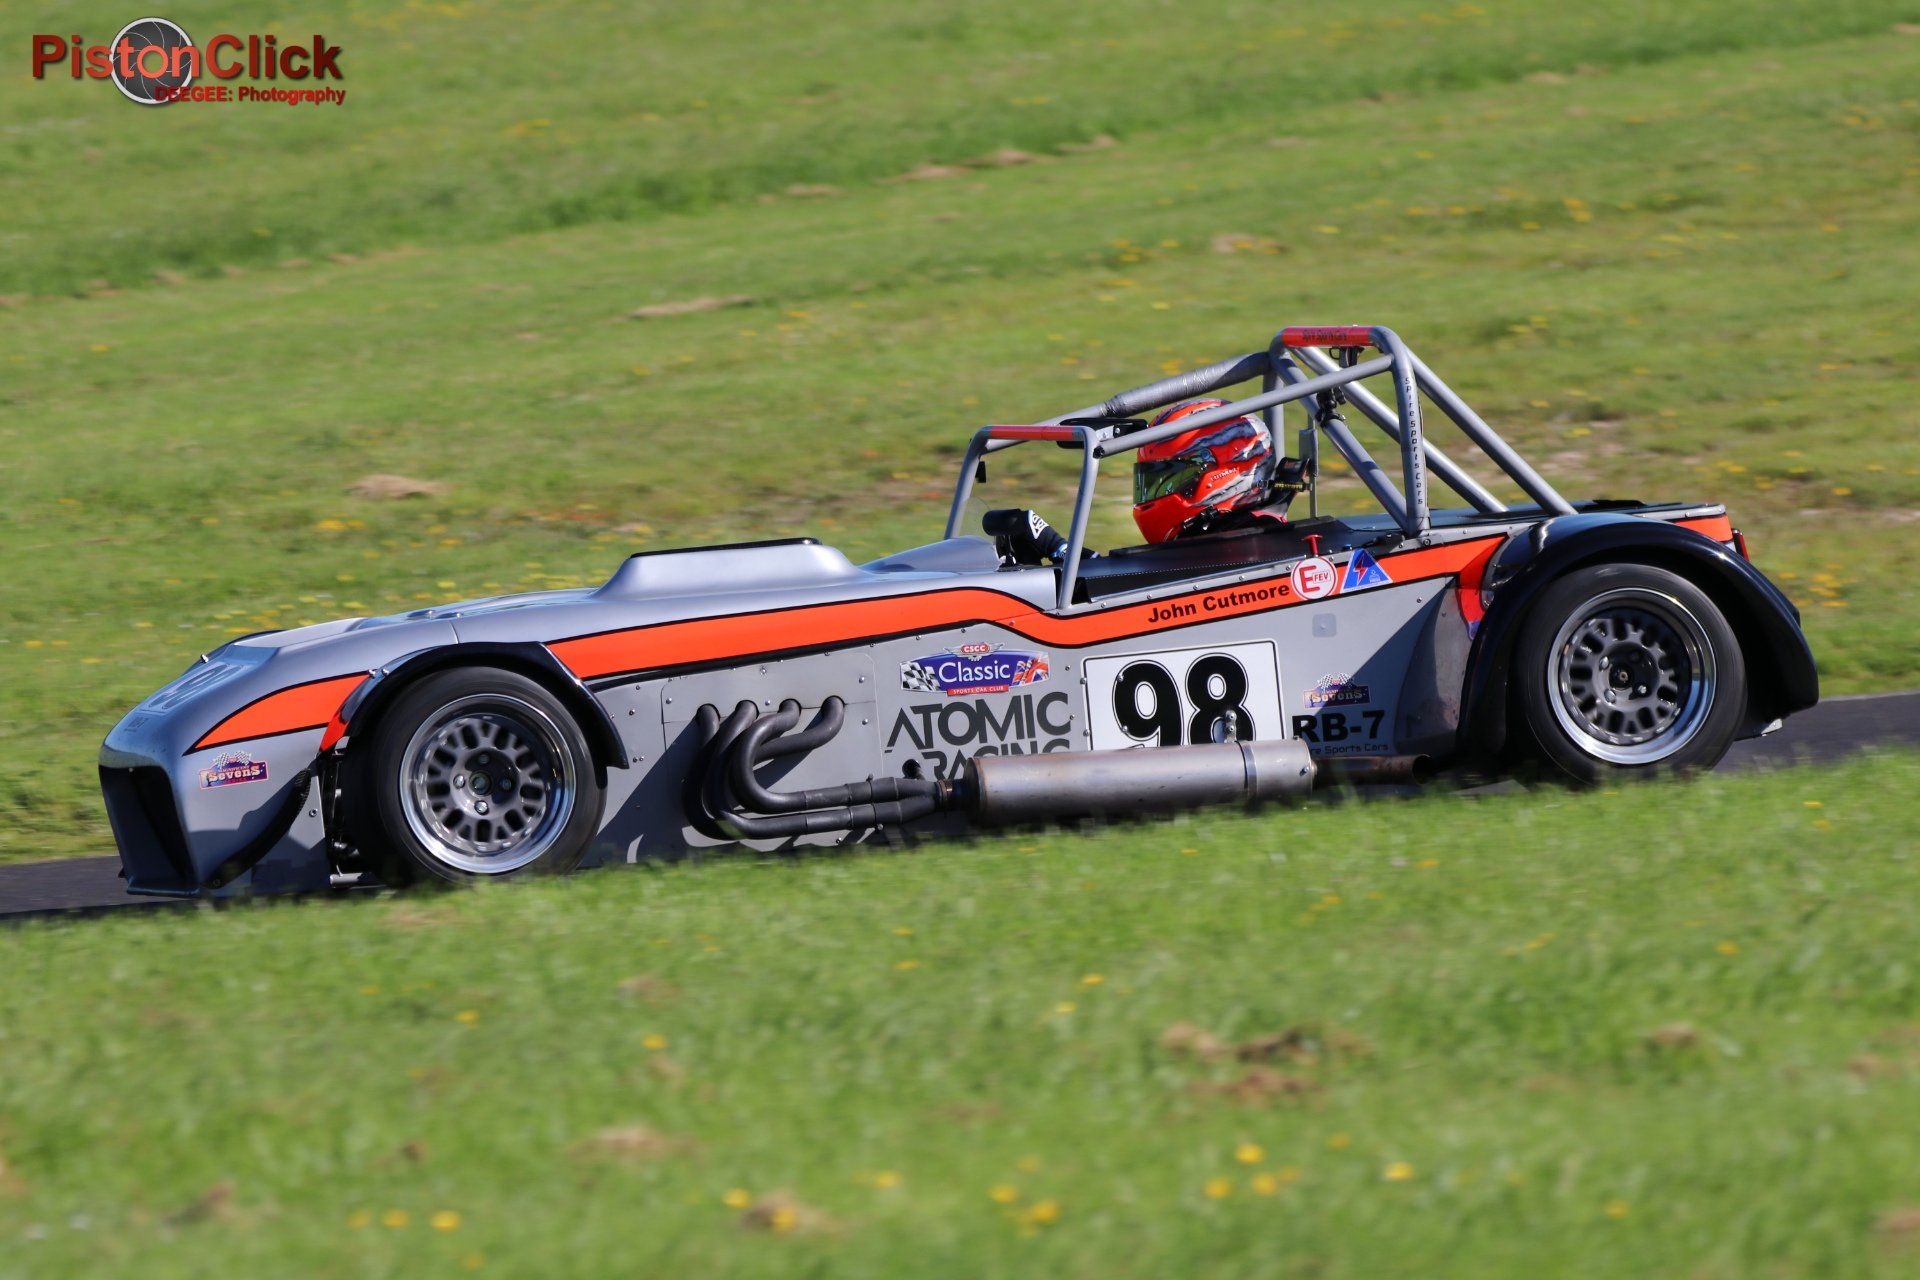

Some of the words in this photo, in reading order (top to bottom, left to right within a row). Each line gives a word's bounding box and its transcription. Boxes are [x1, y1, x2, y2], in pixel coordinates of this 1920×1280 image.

[1298, 565, 1320, 593] E
[1314, 572, 1329, 582] FEV
[1148, 603, 1198, 624] John
[1202, 584, 1290, 612] Cutmore
[963, 644, 987, 653] CSCC
[938, 660, 1011, 683] Classic
[952, 687, 974, 695] SPORTS
[975, 686, 988, 694] CAR
[989, 685, 1005, 693] CLUB
[1112, 652, 1256, 750] 98
[885, 691, 1071, 752] ATOMIC
[1292, 710, 1385, 742] RB-7
[1325, 744, 1361, 755] Sports
